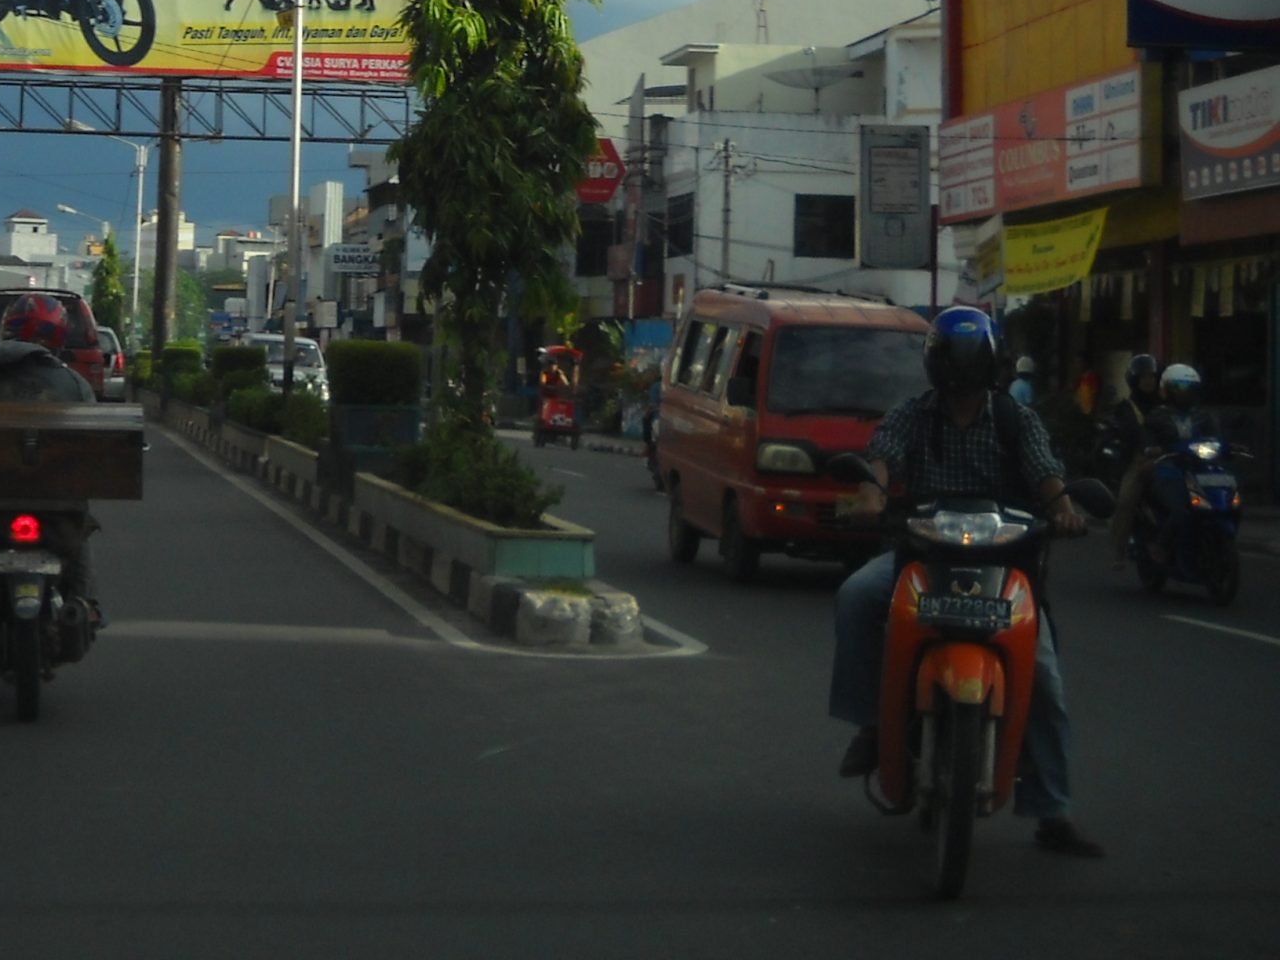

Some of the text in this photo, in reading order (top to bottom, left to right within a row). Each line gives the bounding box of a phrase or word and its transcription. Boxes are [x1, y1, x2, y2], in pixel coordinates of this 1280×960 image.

[182, 25, 214, 39] Pasti
[217, 25, 268, 42] Tangguh,
[345, 26, 366, 39] dan
[369, 25, 405, 41] Gaya!
[323, 57, 359, 70] SURYA
